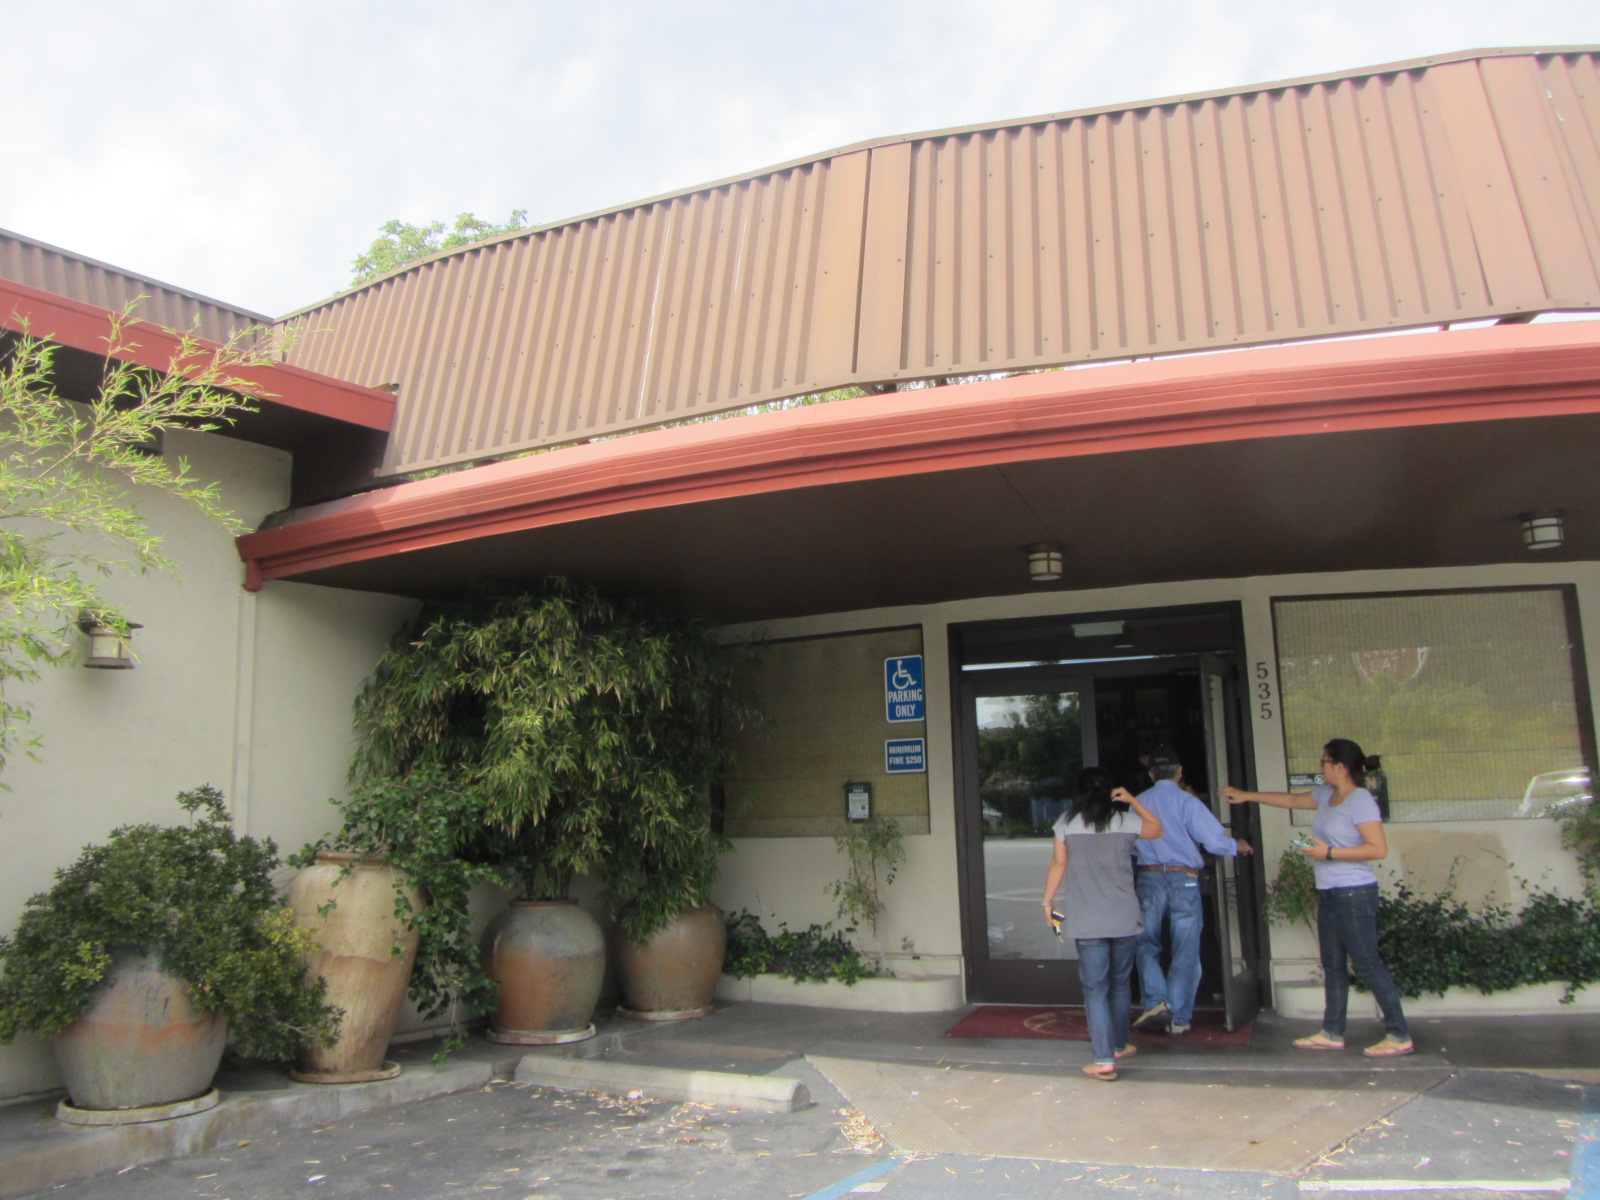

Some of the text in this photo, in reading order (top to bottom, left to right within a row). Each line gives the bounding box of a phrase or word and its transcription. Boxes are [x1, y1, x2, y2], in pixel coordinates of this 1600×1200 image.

[888, 689, 923, 703] PARKING
[1256, 661, 1273, 720] 535
[895, 704, 916, 718] ONLY
[889, 745, 921, 755] MINIMUM
[889, 755, 922, 765] FINE $250
